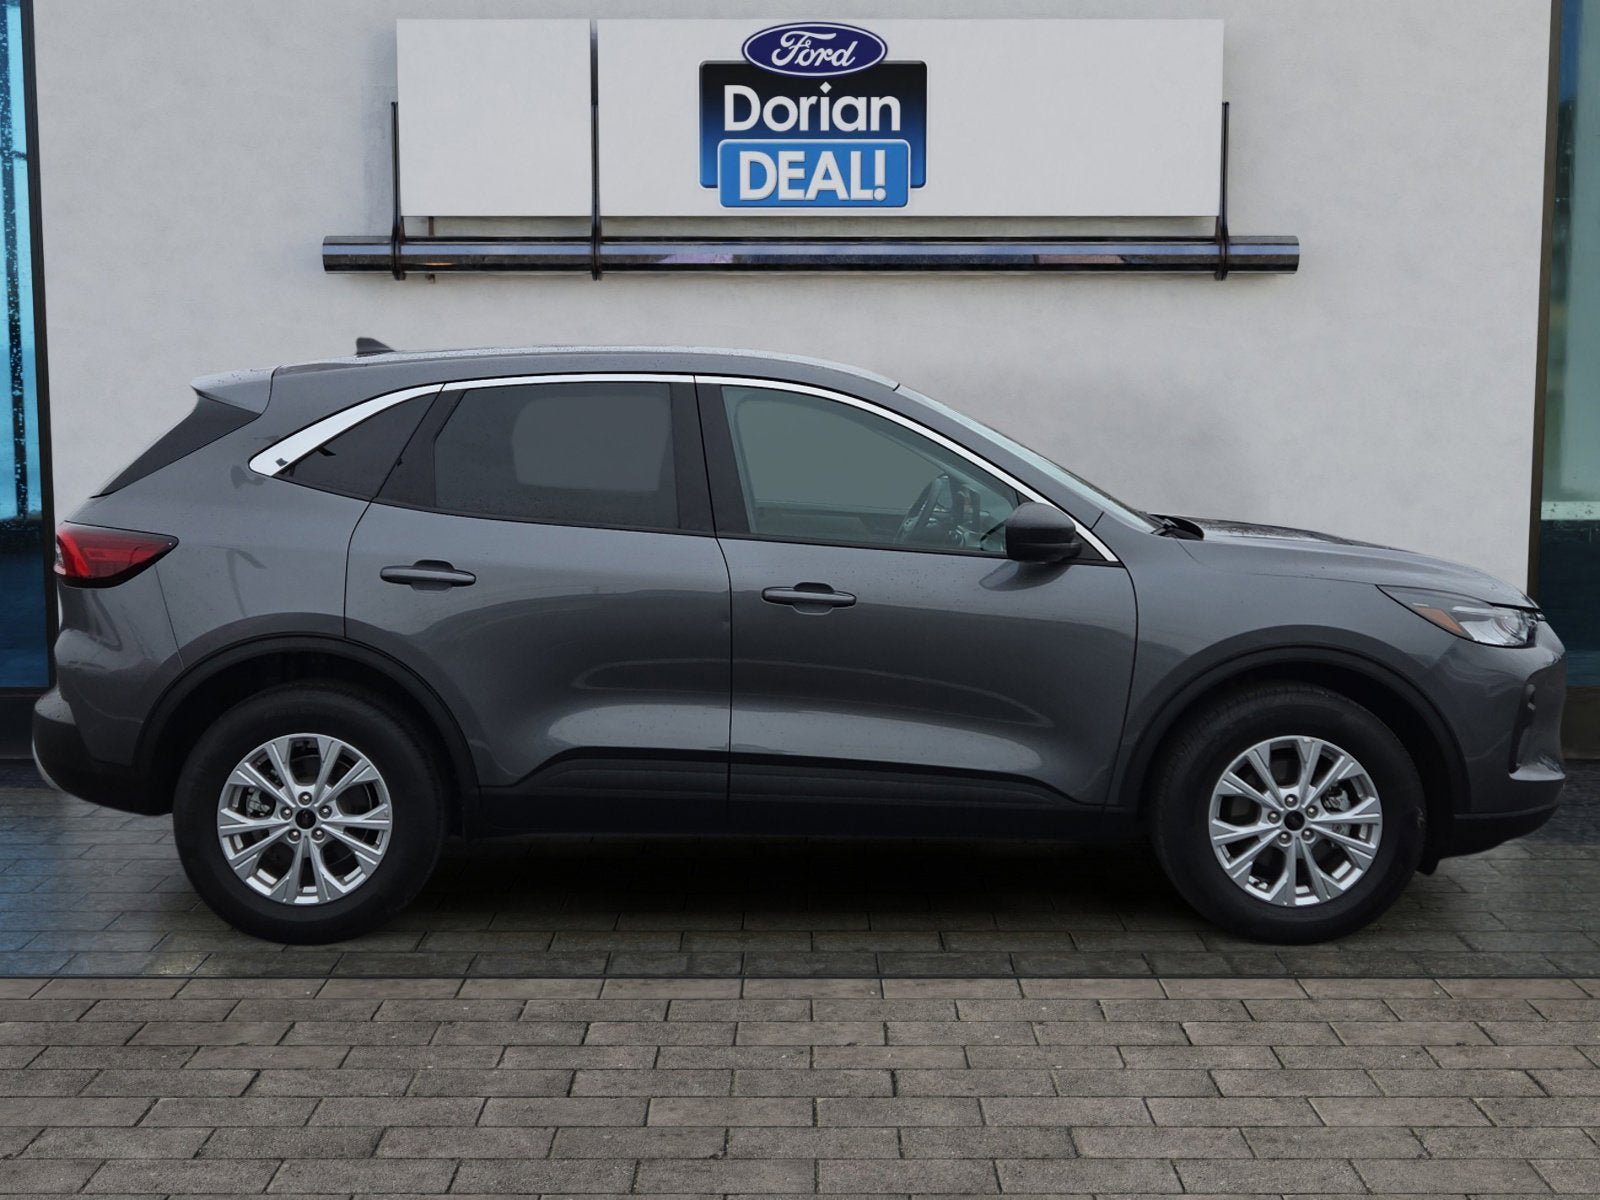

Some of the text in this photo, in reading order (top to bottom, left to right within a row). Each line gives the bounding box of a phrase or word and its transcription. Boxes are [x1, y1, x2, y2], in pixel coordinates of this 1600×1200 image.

[771, 30, 858, 67] Ford
[724, 81, 901, 132] Dorian
[739, 149, 887, 201] DEAL!
